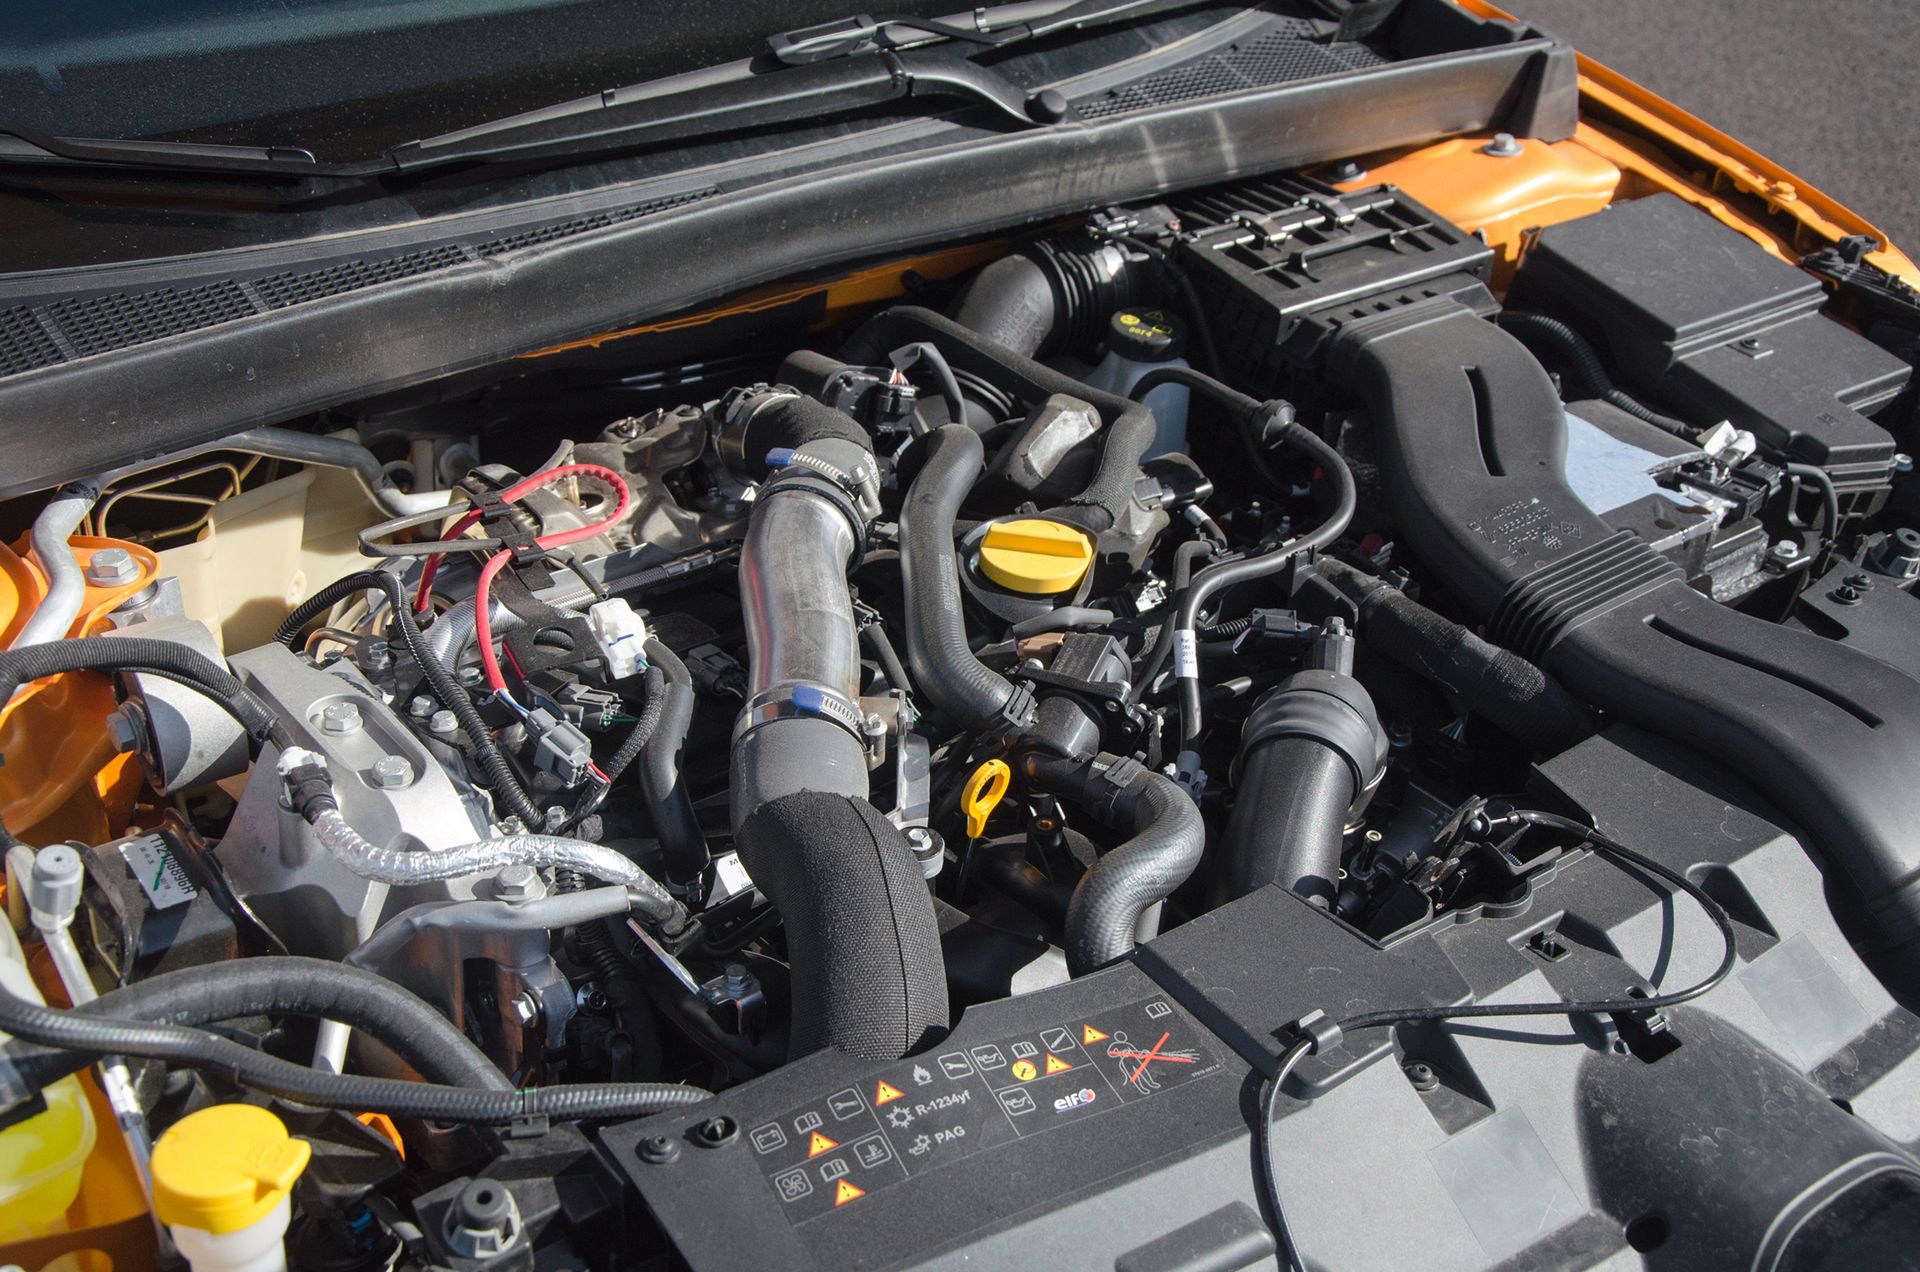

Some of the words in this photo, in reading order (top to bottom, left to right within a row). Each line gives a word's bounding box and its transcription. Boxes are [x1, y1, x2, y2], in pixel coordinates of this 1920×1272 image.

[914, 1089, 971, 1116] R-1234yf
[1054, 1092, 1079, 1109] elf
[934, 1126, 966, 1144] PAG
